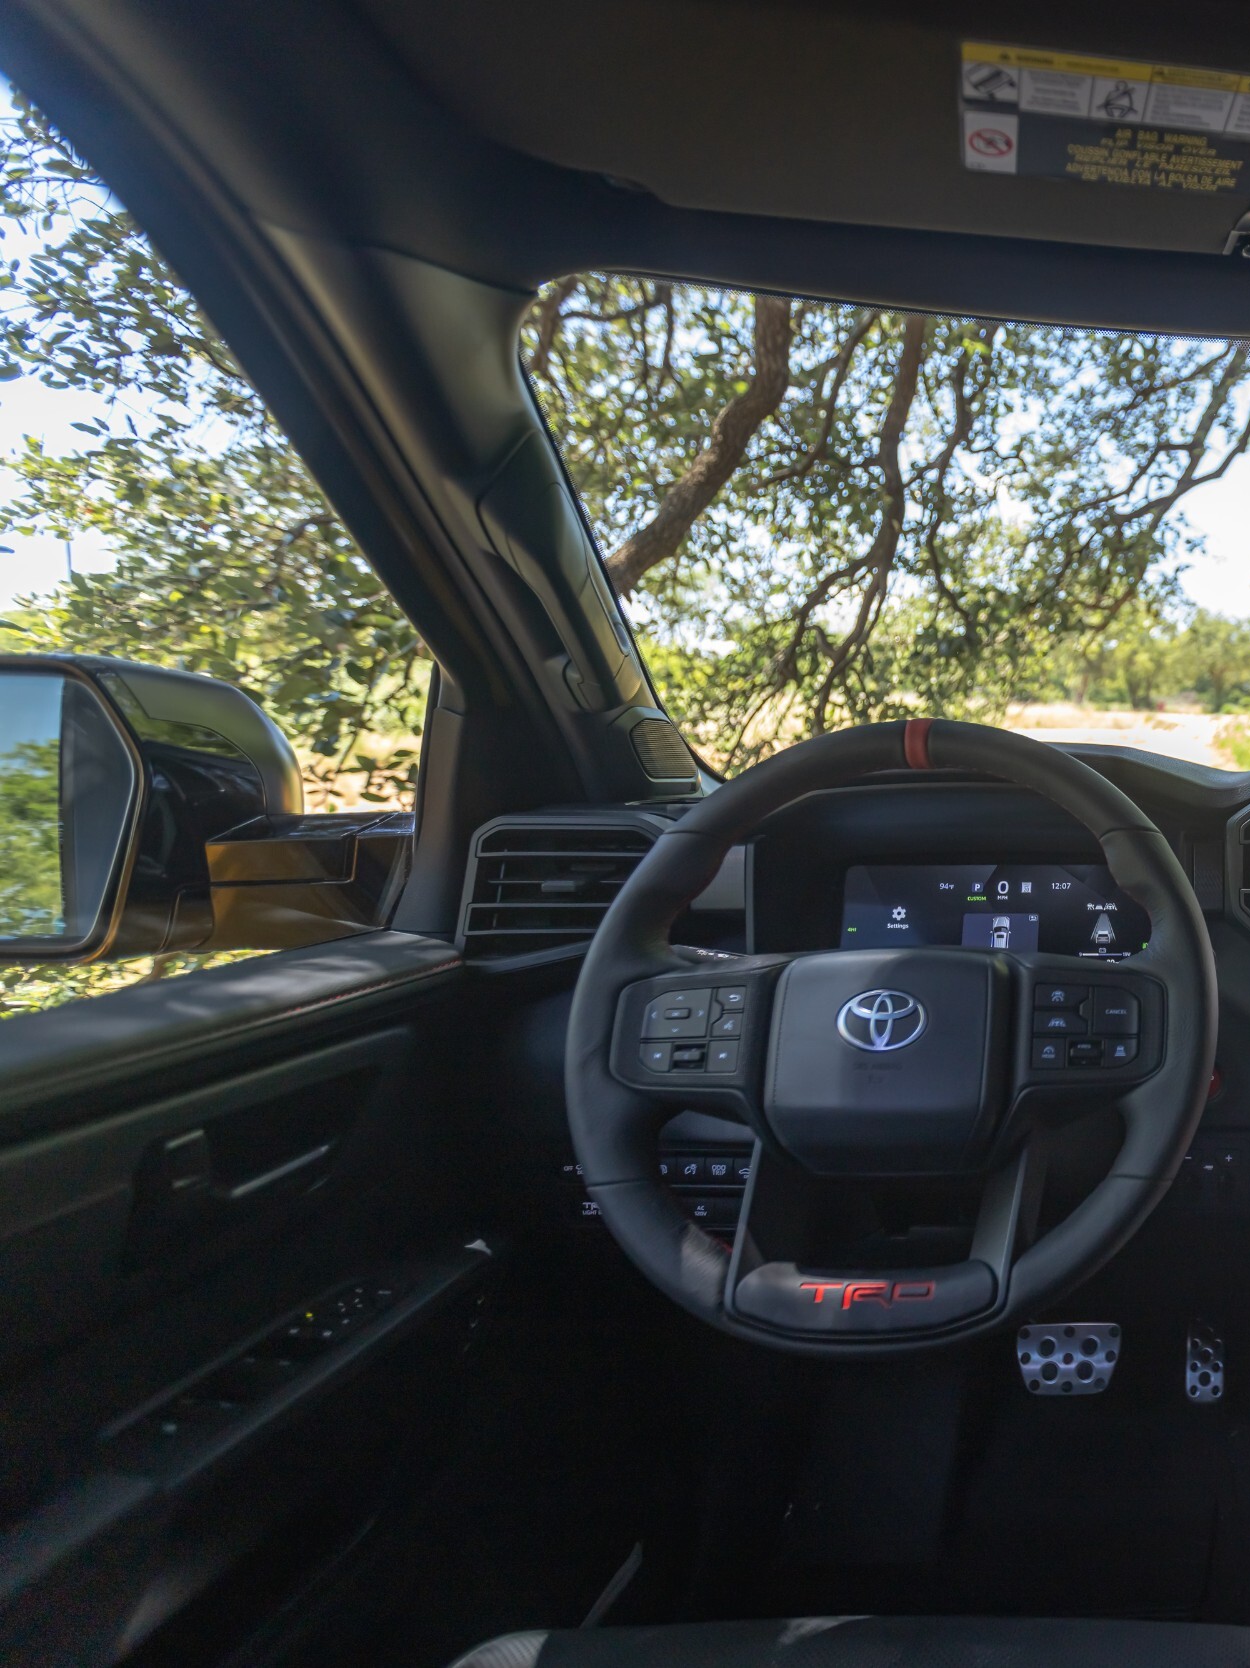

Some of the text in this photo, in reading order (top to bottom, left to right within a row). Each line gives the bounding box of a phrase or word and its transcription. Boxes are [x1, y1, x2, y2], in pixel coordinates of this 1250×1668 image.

[1115, 128, 1208, 146] AIR BAG WARNING
[1136, 141, 1174, 152] VISOR
[1182, 146, 1216, 156] OVER
[1067, 144, 1109, 157] COUSSIN
[1169, 154, 1244, 170] AVERTISSEMENT
[1066, 162, 1237, 186] ADVERTENCIA CON LA BOLSA DE AIRE
[1182, 182, 1218, 192] VISOR
[998, 880, 1009, 894] 0
[582, 1202, 600, 1210] TR
[800, 1280, 936, 1310] TRD
